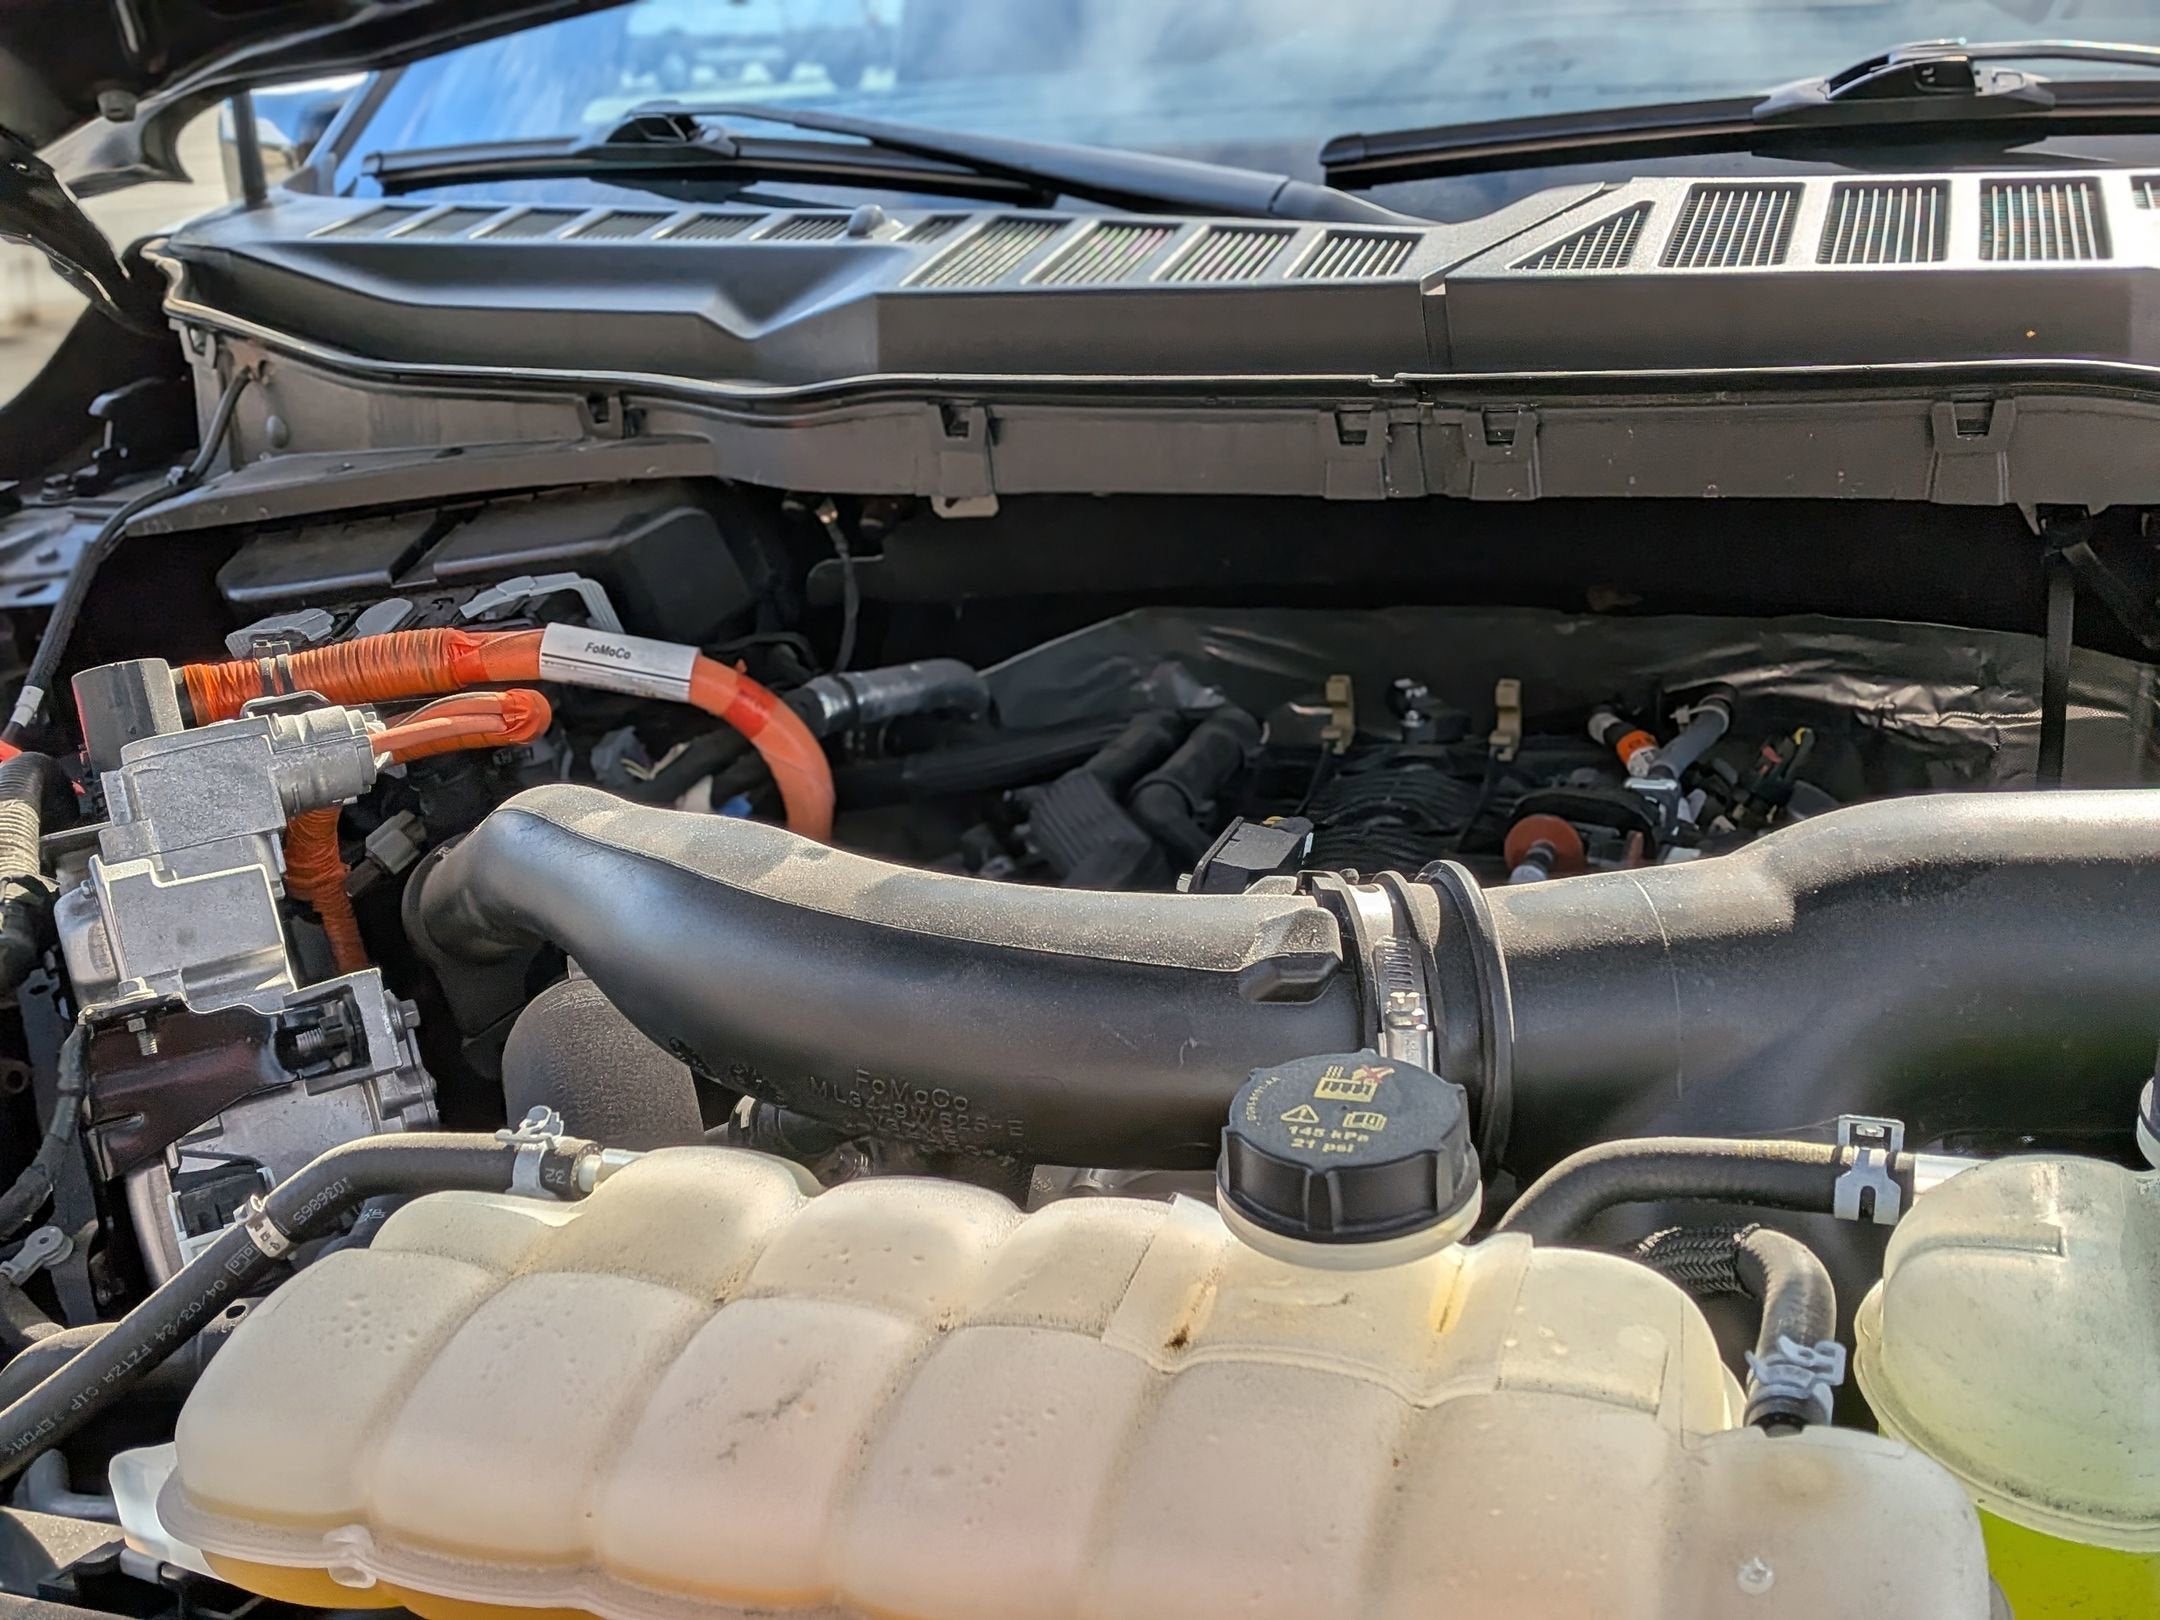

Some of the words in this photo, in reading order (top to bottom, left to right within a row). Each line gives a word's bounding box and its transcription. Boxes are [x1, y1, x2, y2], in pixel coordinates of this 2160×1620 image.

[584, 642, 632, 660] FoMoCo
[855, 1068, 969, 1112] FoMoCo
[1288, 1125, 1325, 1139] 145
[1331, 1130, 1369, 1142] kPa
[1291, 1137, 1315, 1149] 21
[1323, 1142, 1354, 1153] psi
